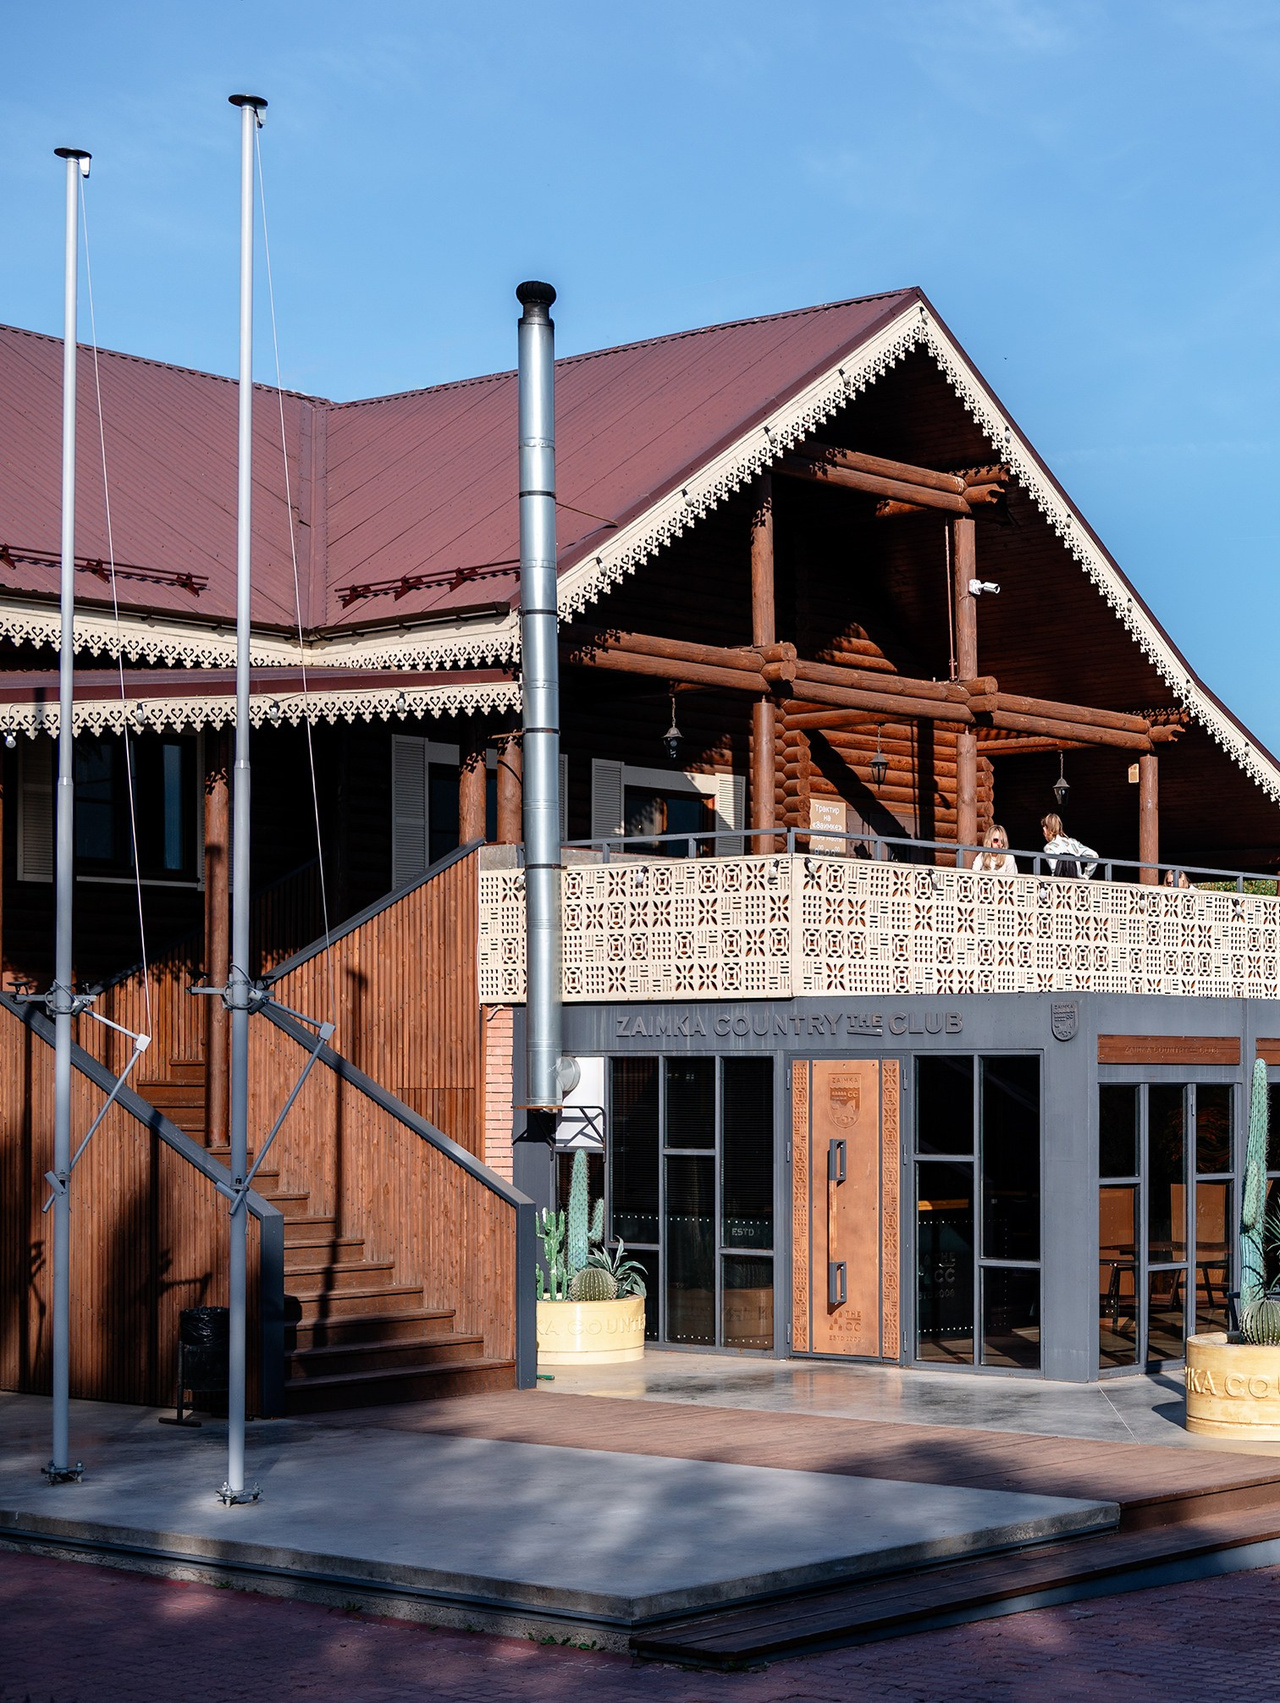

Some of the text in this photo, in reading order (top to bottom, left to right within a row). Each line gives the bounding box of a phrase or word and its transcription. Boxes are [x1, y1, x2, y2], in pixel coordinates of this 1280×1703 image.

[815, 804, 840, 815] Трактир
[823, 814, 832, 822] на
[616, 1011, 964, 1037] ZAIMKA COUNTRY THE CLUB
[731, 1227, 755, 1237] ESTD
[846, 1310, 861, 1318] THE
[846, 1321, 861, 1332] CC
